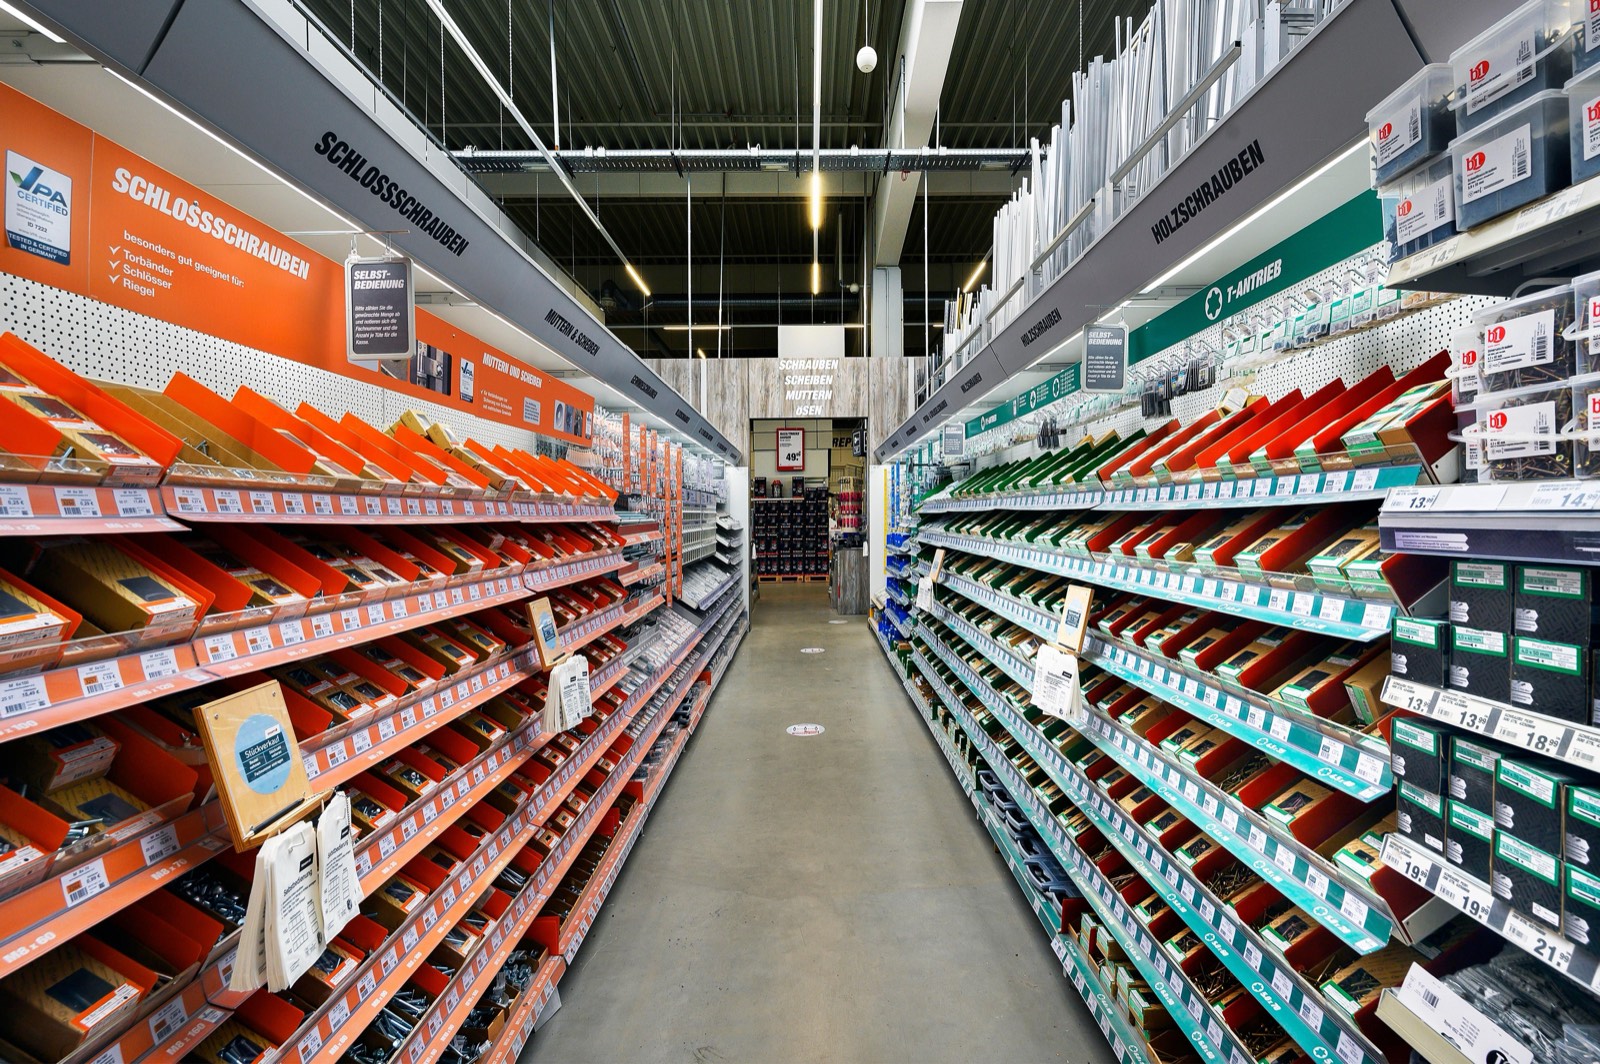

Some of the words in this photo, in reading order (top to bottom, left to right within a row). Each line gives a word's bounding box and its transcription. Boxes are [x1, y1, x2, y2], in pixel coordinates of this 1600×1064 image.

[1466, 151, 1486, 171] b1
[17, 190, 68, 216] CERTIFIED
[314, 131, 470, 257] SCHLOSSSCHRAUBEN
[1151, 139, 1265, 245] HOLZSCHRAUBEN
[35, 223, 48, 234] 7222
[112, 167, 310, 280] SCHLOSSSCHRAUBEN
[9, 232, 32, 246] TESTED
[38, 242, 68, 258] CERTIFIED
[20, 242, 27, 250] IN
[28, 246, 57, 260] GERMANY
[124, 230, 175, 258] besonders
[178, 248, 193, 268] gut
[194, 252, 229, 283] geeignet
[230, 270, 245, 289] für:
[124, 250, 173, 277] Torbänder
[123, 264, 173, 290] Schlösser
[353, 270, 391, 280] SELBST-
[353, 279, 404, 290] BEDIENUNG
[1226, 258, 1282, 304] T-ANTRIEB
[124, 278, 155, 298] Riegel
[544, 309, 572, 337] MUTTERN
[1020, 308, 1062, 347] HOLZSCHRAUBEN
[1088, 331, 1113, 339] SELBST-
[1088, 338, 1123, 346] BEDIENUNG
[1487, 326, 1506, 344] b1
[482, 352, 509, 374] MUTTERN
[509, 364, 521, 379] UND
[779, 359, 838, 370] SCHRAUBEN
[784, 375, 833, 385] SCHEIBEN
[786, 390, 832, 400] MUTTERN
[796, 405, 822, 416] ÖSEN
[1489, 412, 1507, 429] b1
[1460, 710, 1488, 730] 13.99
[244, 735, 280, 759] Stückverkauf
[1526, 732, 1559, 753] 18.99
[151, 868, 170, 880] M8
[173, 858, 188, 868] 70
[1404, 861, 1428, 883] 19.99
[1463, 895, 1490, 920] 19.99
[2, 946, 30, 964] M8
[29, 942, 38, 951] x
[35, 931, 56, 945] 60
[1533, 937, 1570, 967] 21.99
[166, 1040, 185, 1056] M8
[187, 1022, 206, 1037] 160
